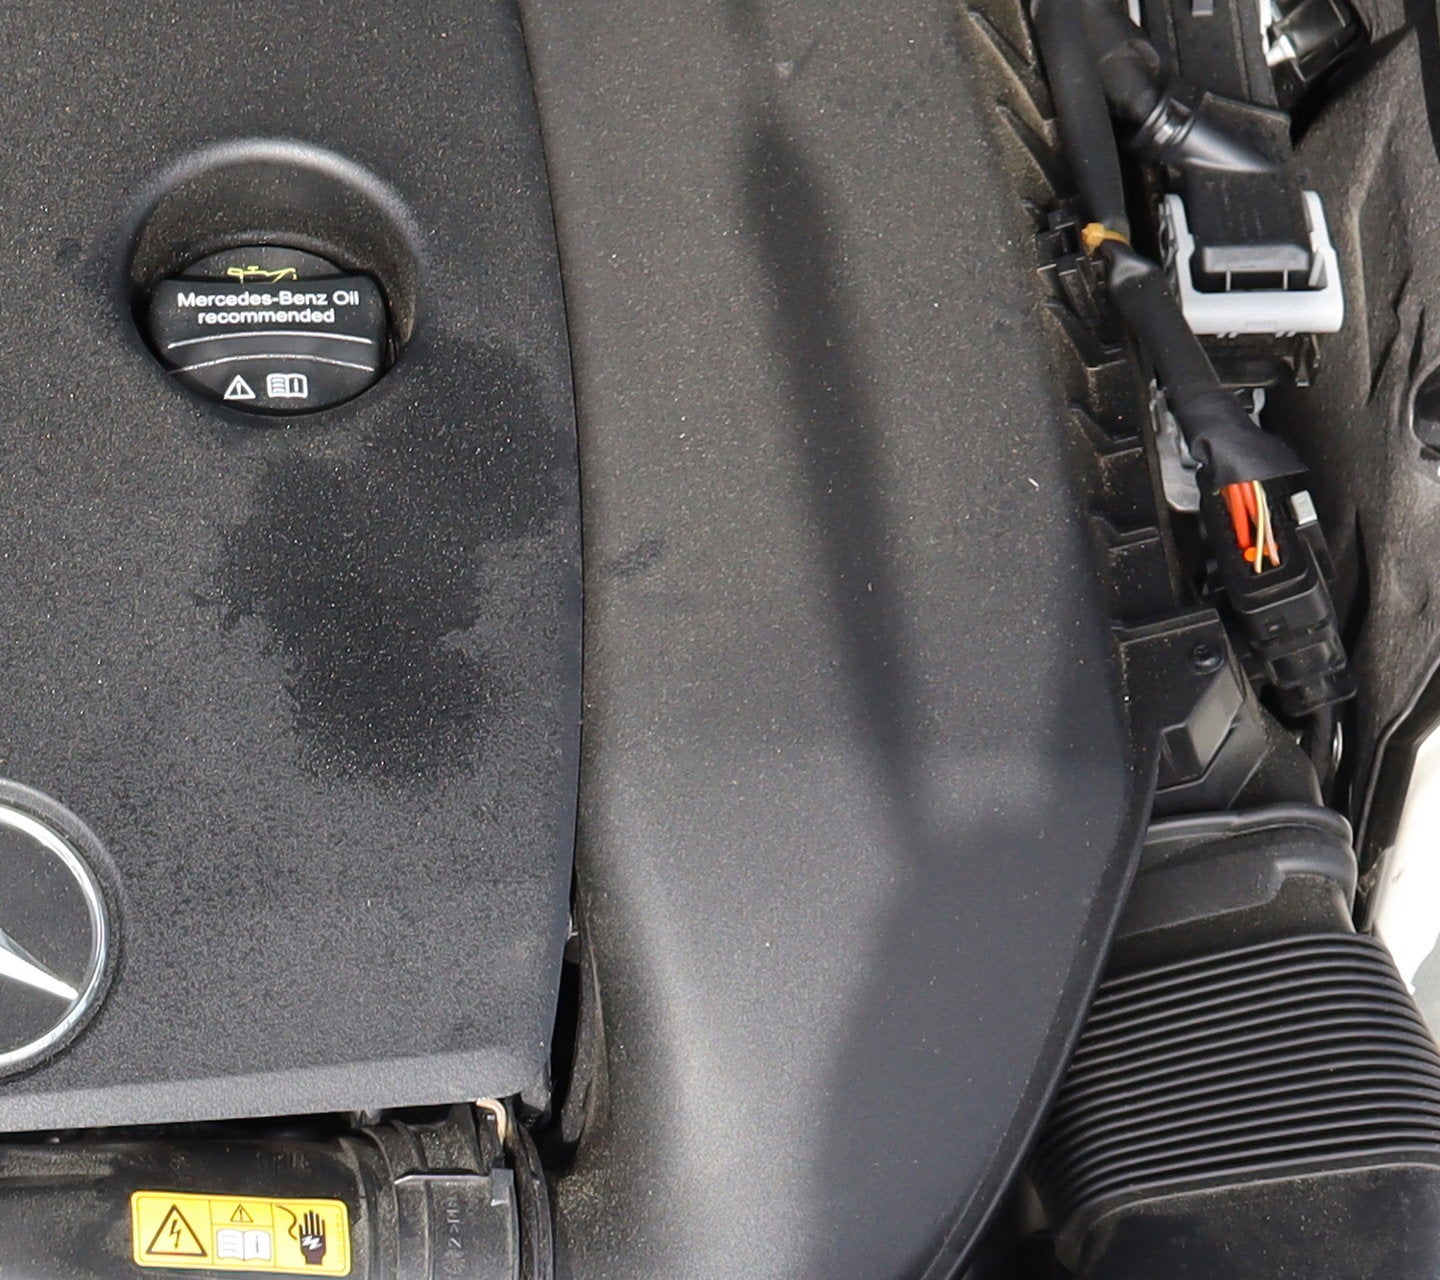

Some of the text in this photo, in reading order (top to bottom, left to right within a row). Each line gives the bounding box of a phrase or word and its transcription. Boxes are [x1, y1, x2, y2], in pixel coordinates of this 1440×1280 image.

[176, 290, 360, 309] Mercedes-Benz Oil
[198, 308, 335, 324] recommended
